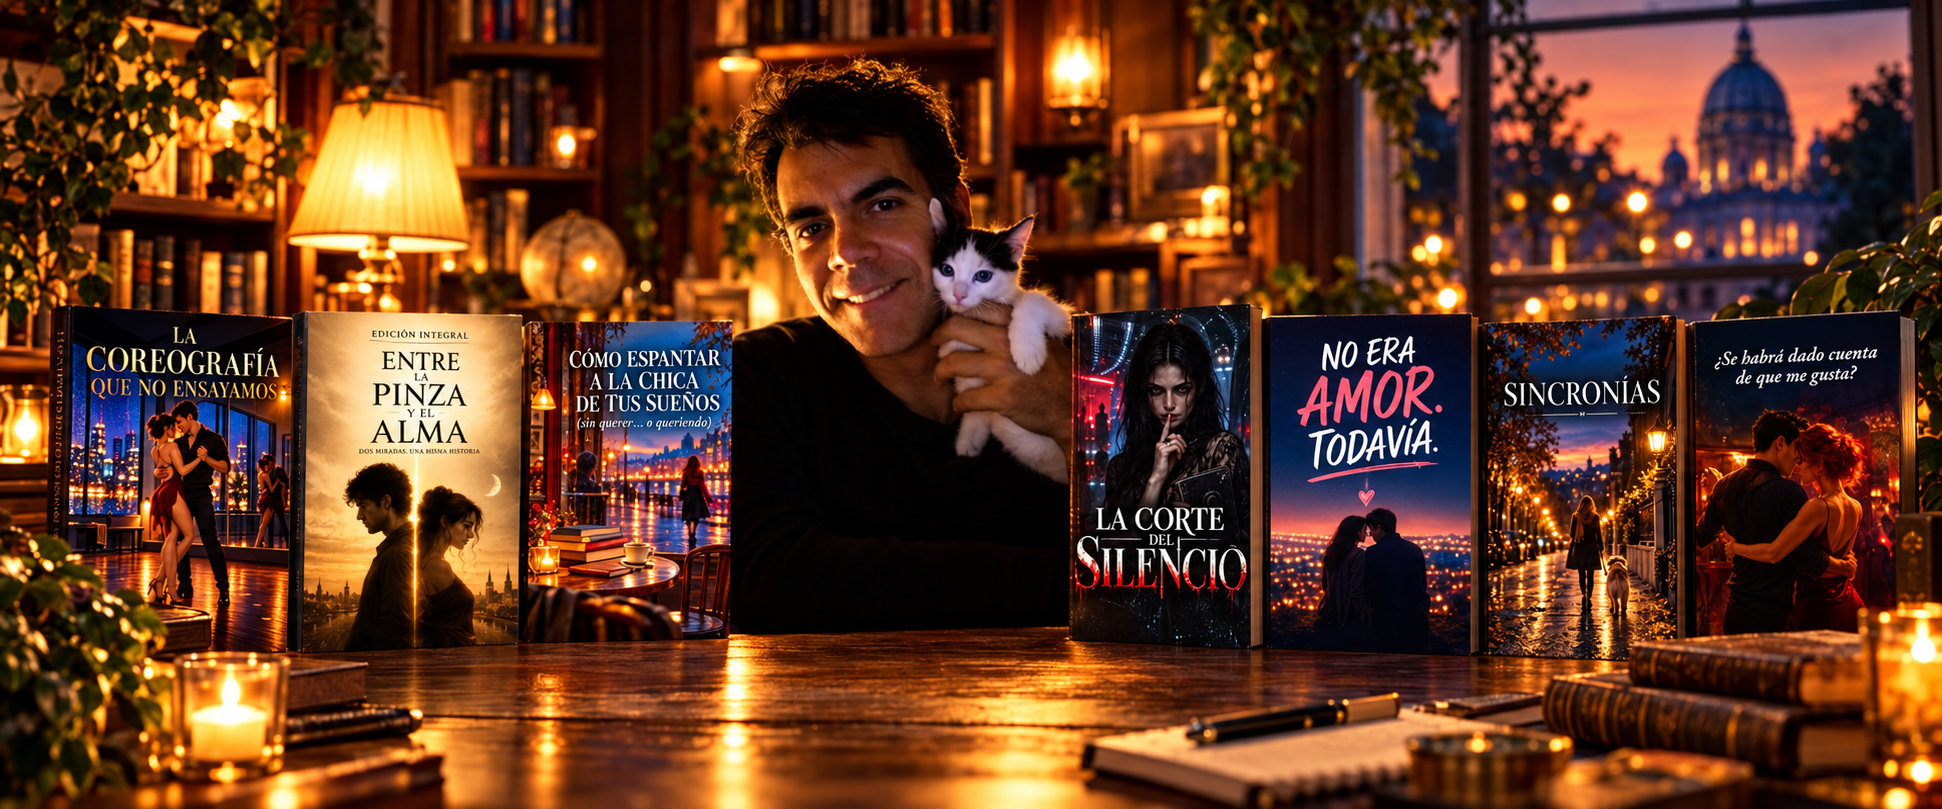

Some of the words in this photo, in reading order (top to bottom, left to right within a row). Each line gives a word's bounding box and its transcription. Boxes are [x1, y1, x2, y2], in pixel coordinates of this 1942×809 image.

[173, 326, 197, 344] LA
[372, 329, 416, 338] EDICIÓN
[419, 331, 469, 339] INTEGRAL
[86, 346, 280, 378] COREOGRAFÍA
[382, 351, 460, 371] ENTRE
[569, 348, 622, 368] CÓMO
[627, 349, 721, 367] ESPANTAR
[1321, 340, 1358, 371] NO
[1366, 335, 1416, 366] ERA
[1714, 350, 1738, 370] ¿Se
[1740, 348, 1784, 365] habrá
[1787, 346, 1825, 363] dado
[1828, 346, 1878, 361] cuenta
[91, 377, 132, 400] QUE
[138, 379, 166, 397] NO
[173, 379, 277, 400] ENSAYAMOS
[414, 373, 428, 381] LA
[589, 372, 603, 390] A
[608, 372, 633, 390] LA
[638, 371, 699, 390] CHICA
[1735, 369, 1752, 385] de
[1755, 373, 1782, 389] que
[1785, 371, 1807, 382] me
[1808, 365, 1858, 386] gusta?
[372, 383, 467, 406] PINZA
[576, 395, 600, 412] DE
[605, 394, 641, 412] TUS
[645, 391, 720, 412] SUEÑOS
[1296, 365, 1443, 427] AMOR.
[1503, 375, 1661, 407] SINCRONÍAS
[407, 409, 415, 418] Y
[420, 409, 435, 418] EL
[577, 418, 596, 430] (sin
[655, 416, 712, 431] queriendo)
[370, 419, 468, 443] ALMA
[1308, 418, 1439, 470] TODAVÍA.
[1095, 507, 1129, 531] LA
[1134, 506, 1225, 536] CORTE
[1149, 534, 1174, 546] DEL
[1074, 535, 1247, 594] SILENCIO
